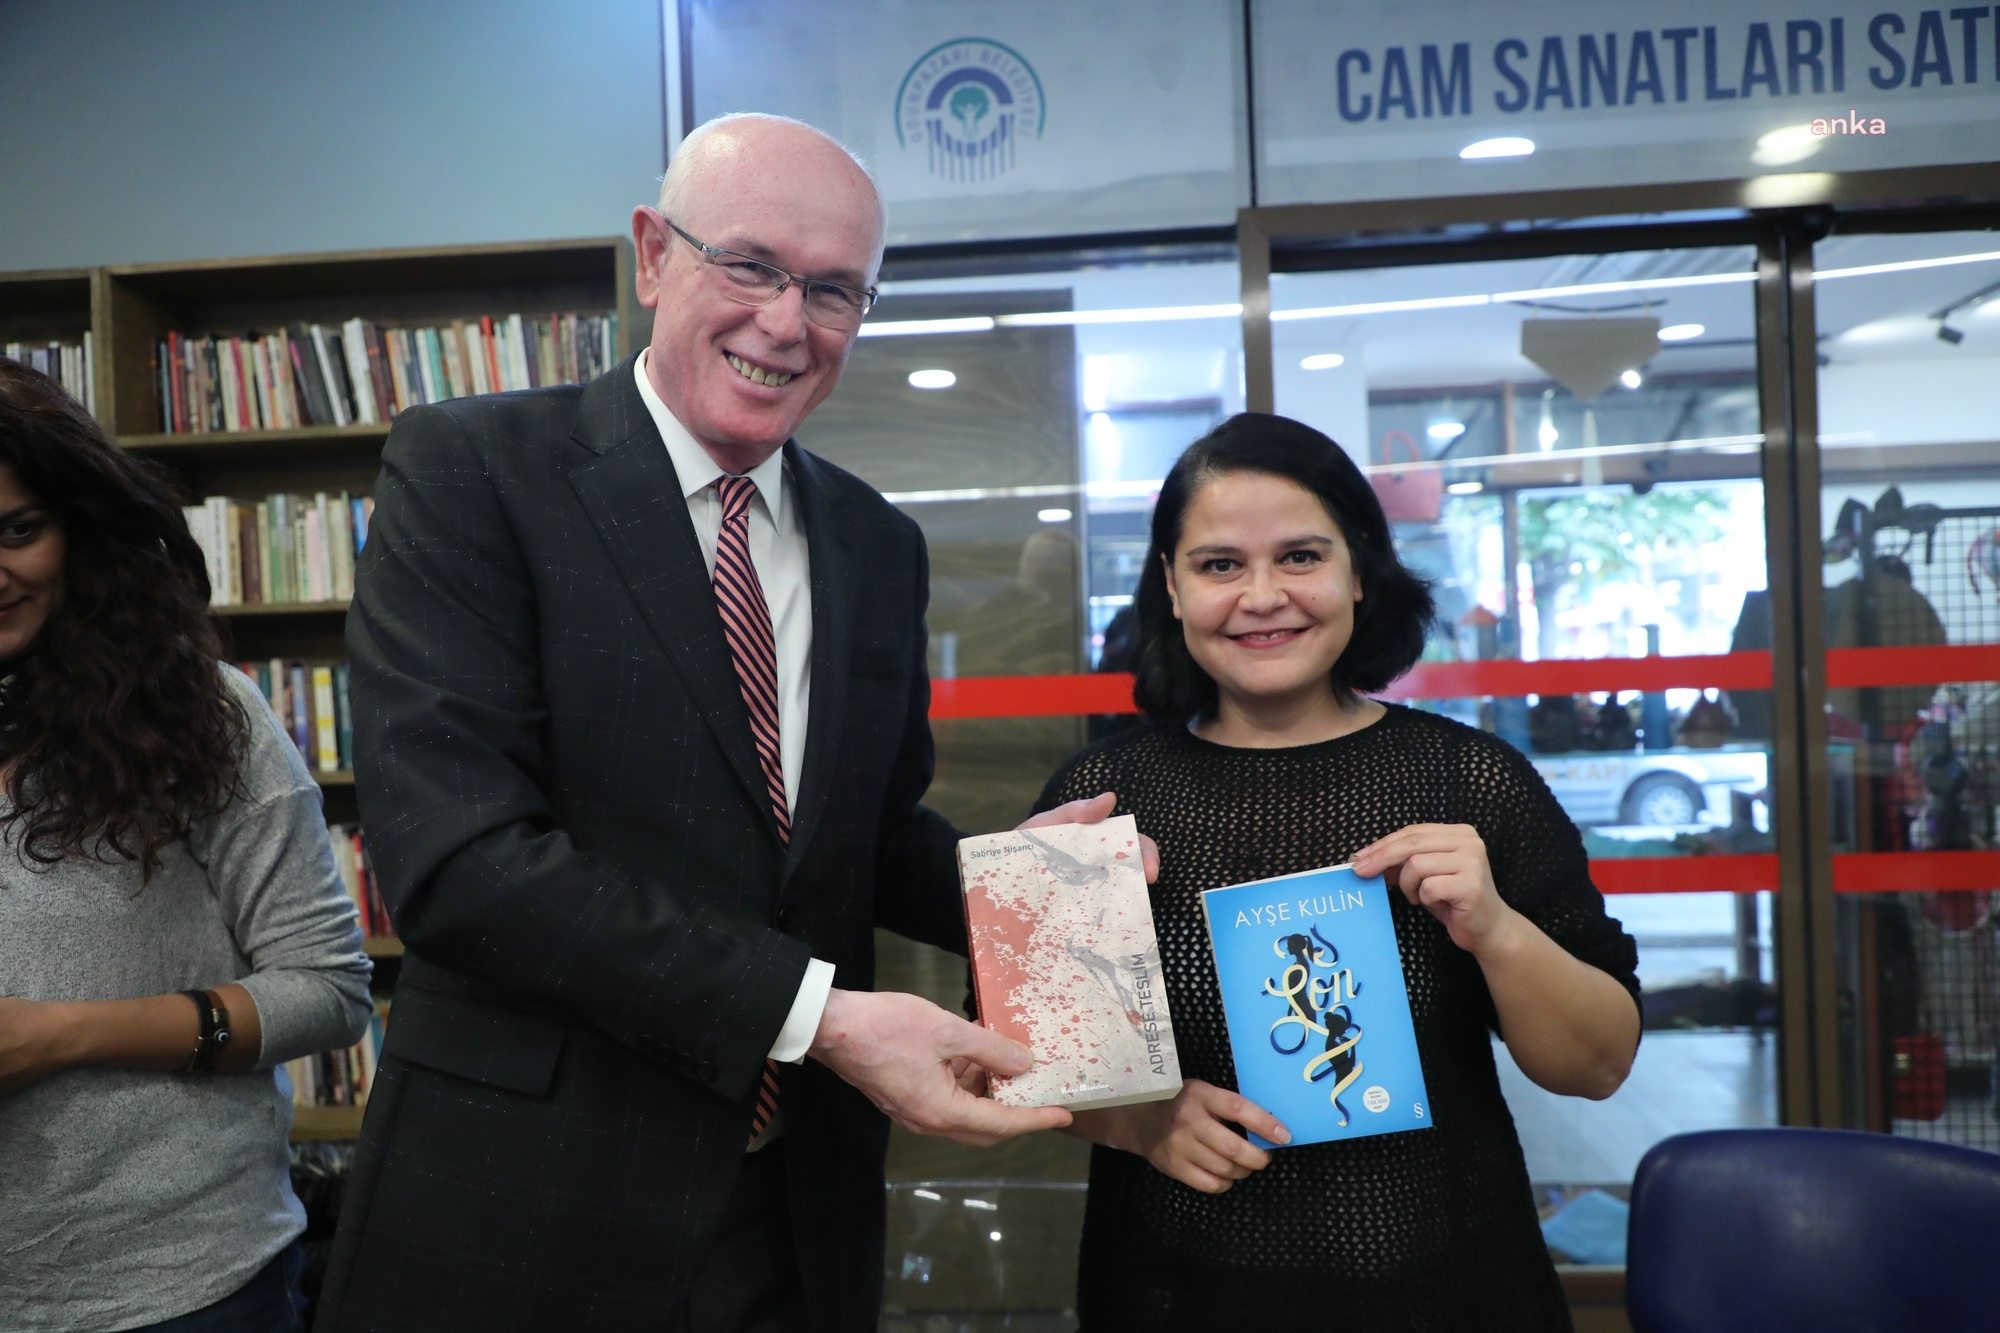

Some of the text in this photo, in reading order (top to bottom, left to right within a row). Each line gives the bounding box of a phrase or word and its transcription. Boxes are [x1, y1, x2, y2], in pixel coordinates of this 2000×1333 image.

[1336, 42, 1472, 123] CAM
[1492, 17, 1846, 114] SANATLARI
[970, 844, 1034, 859] Sabriye Nişancı
[1235, 889, 1364, 928] AYŞE KULİN
[1131, 953, 1166, 1075] ADRESE TESLİM
